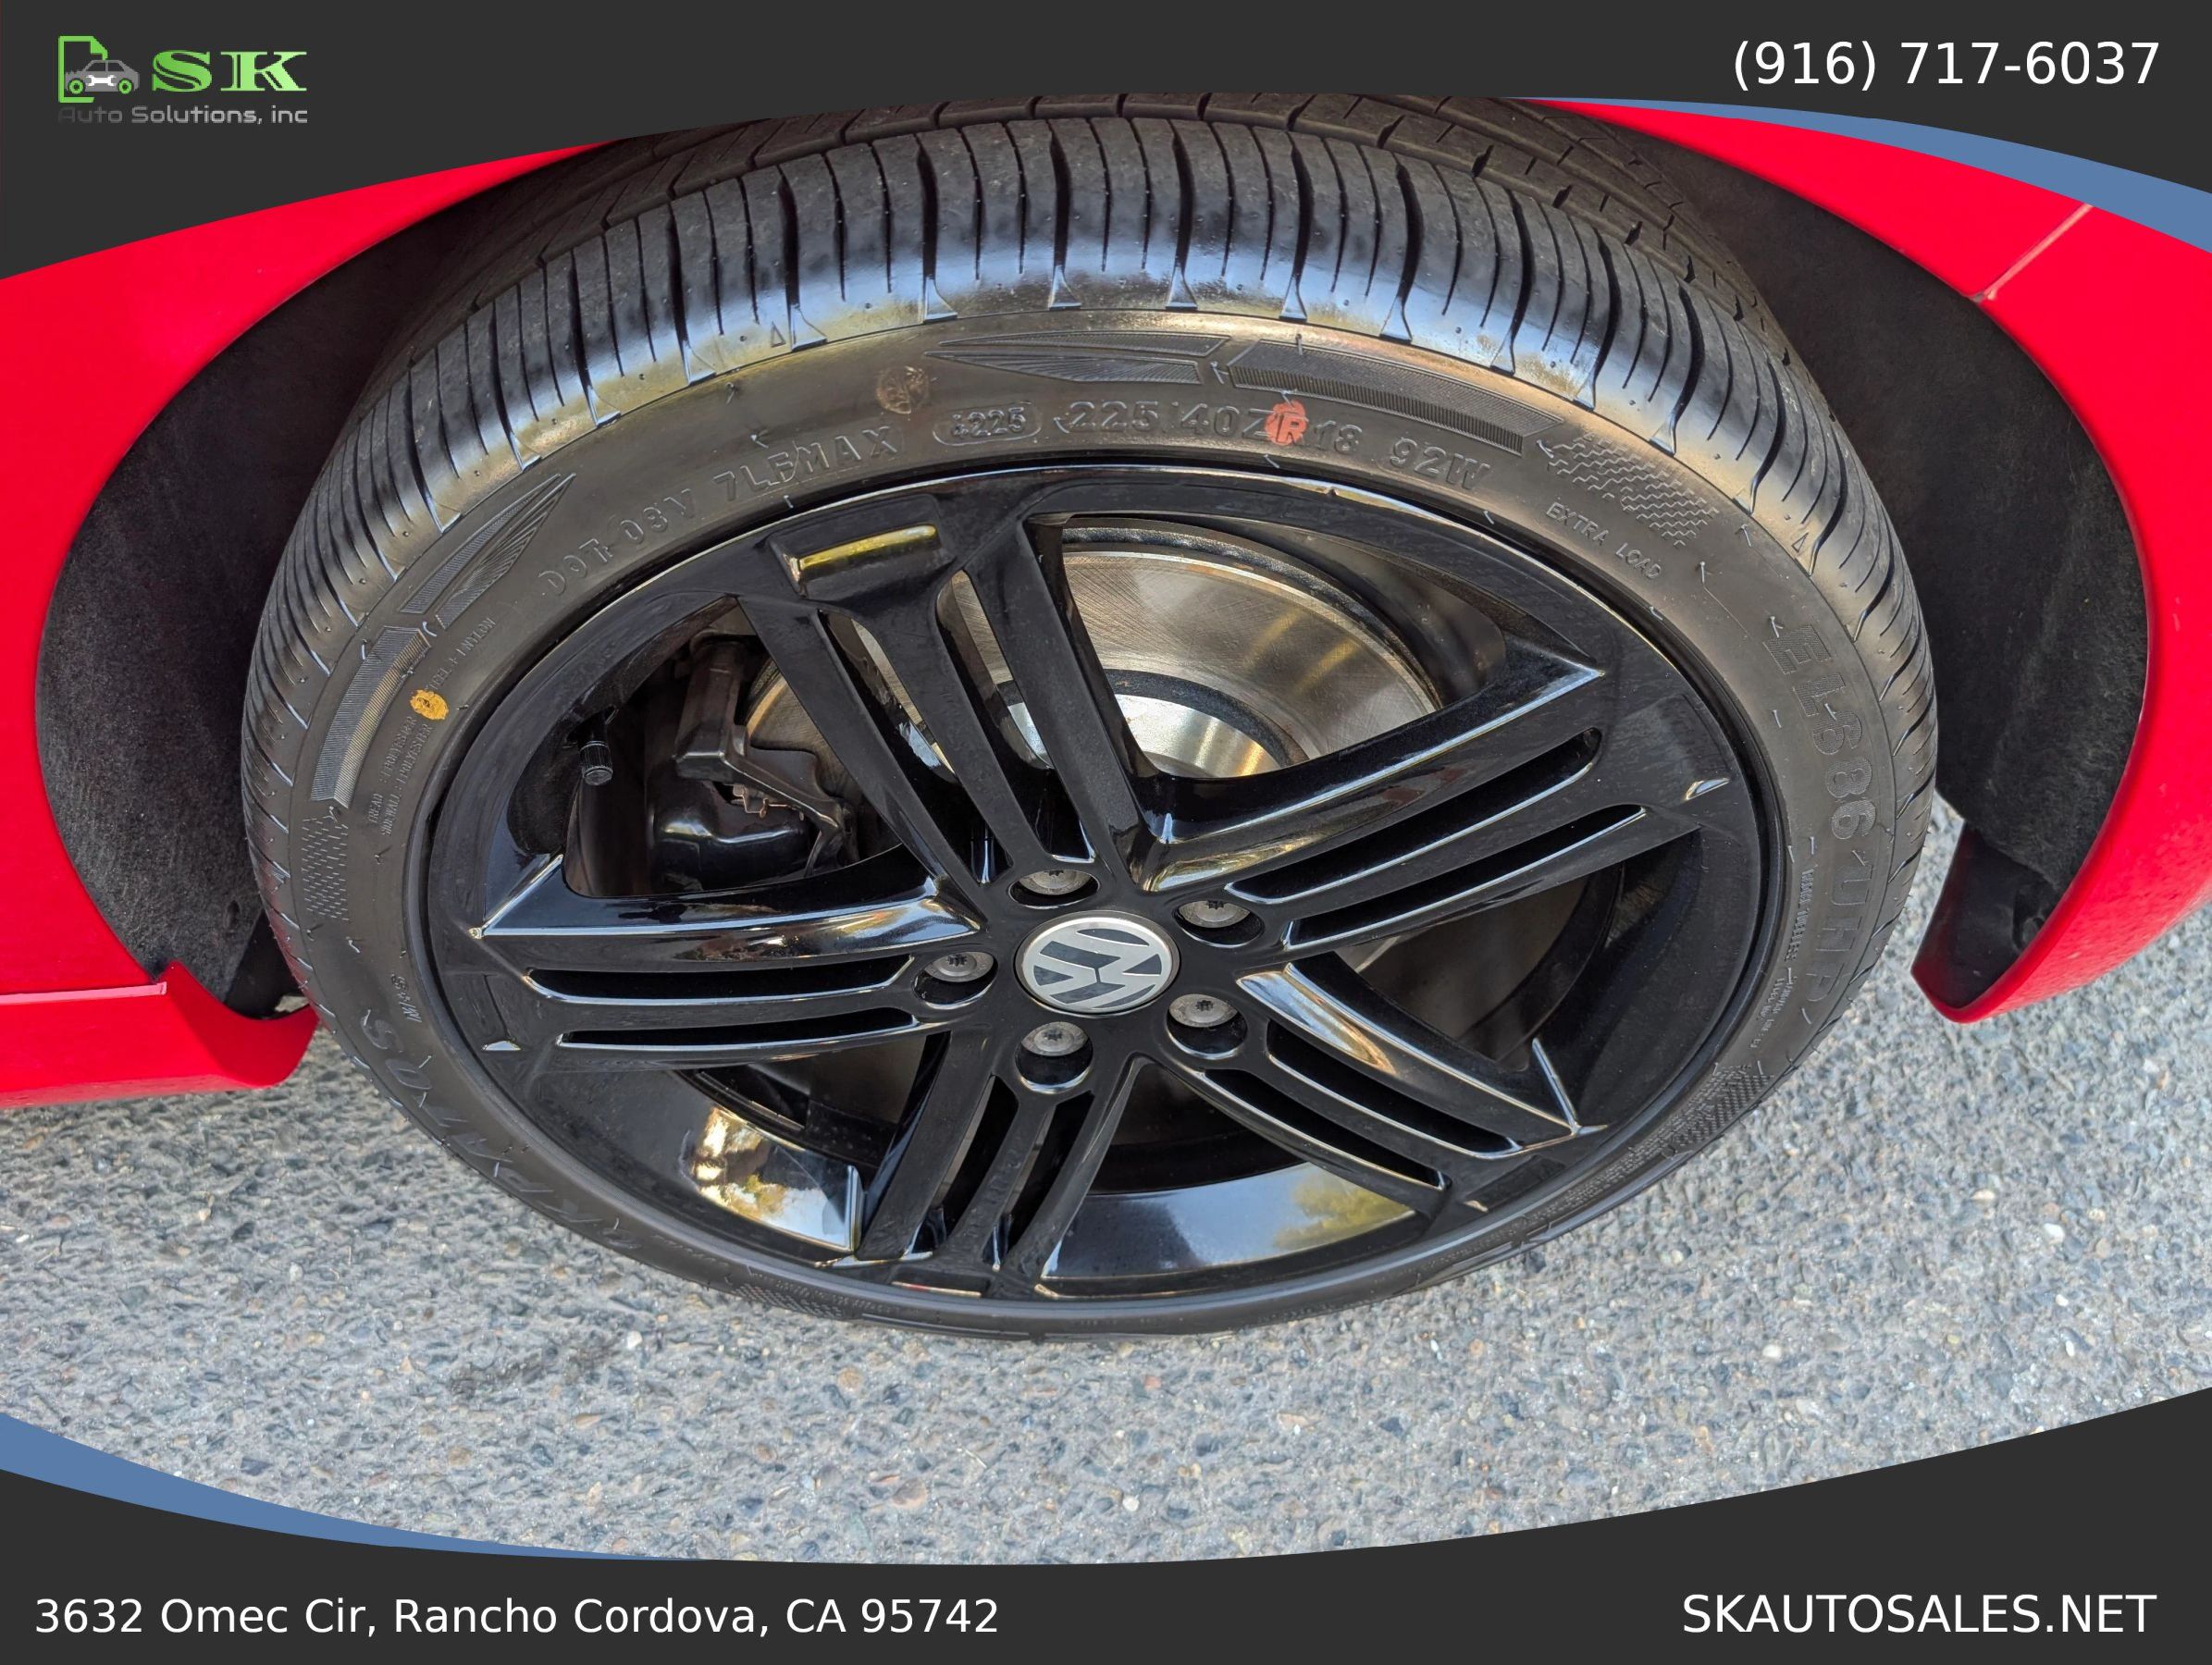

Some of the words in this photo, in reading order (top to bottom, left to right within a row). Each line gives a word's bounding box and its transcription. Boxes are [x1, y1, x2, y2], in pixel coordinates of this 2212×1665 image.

[1386, 437, 1490, 489] 92W
[1545, 501, 1610, 546] EXTRA
[1615, 542, 1662, 579] LOAD
